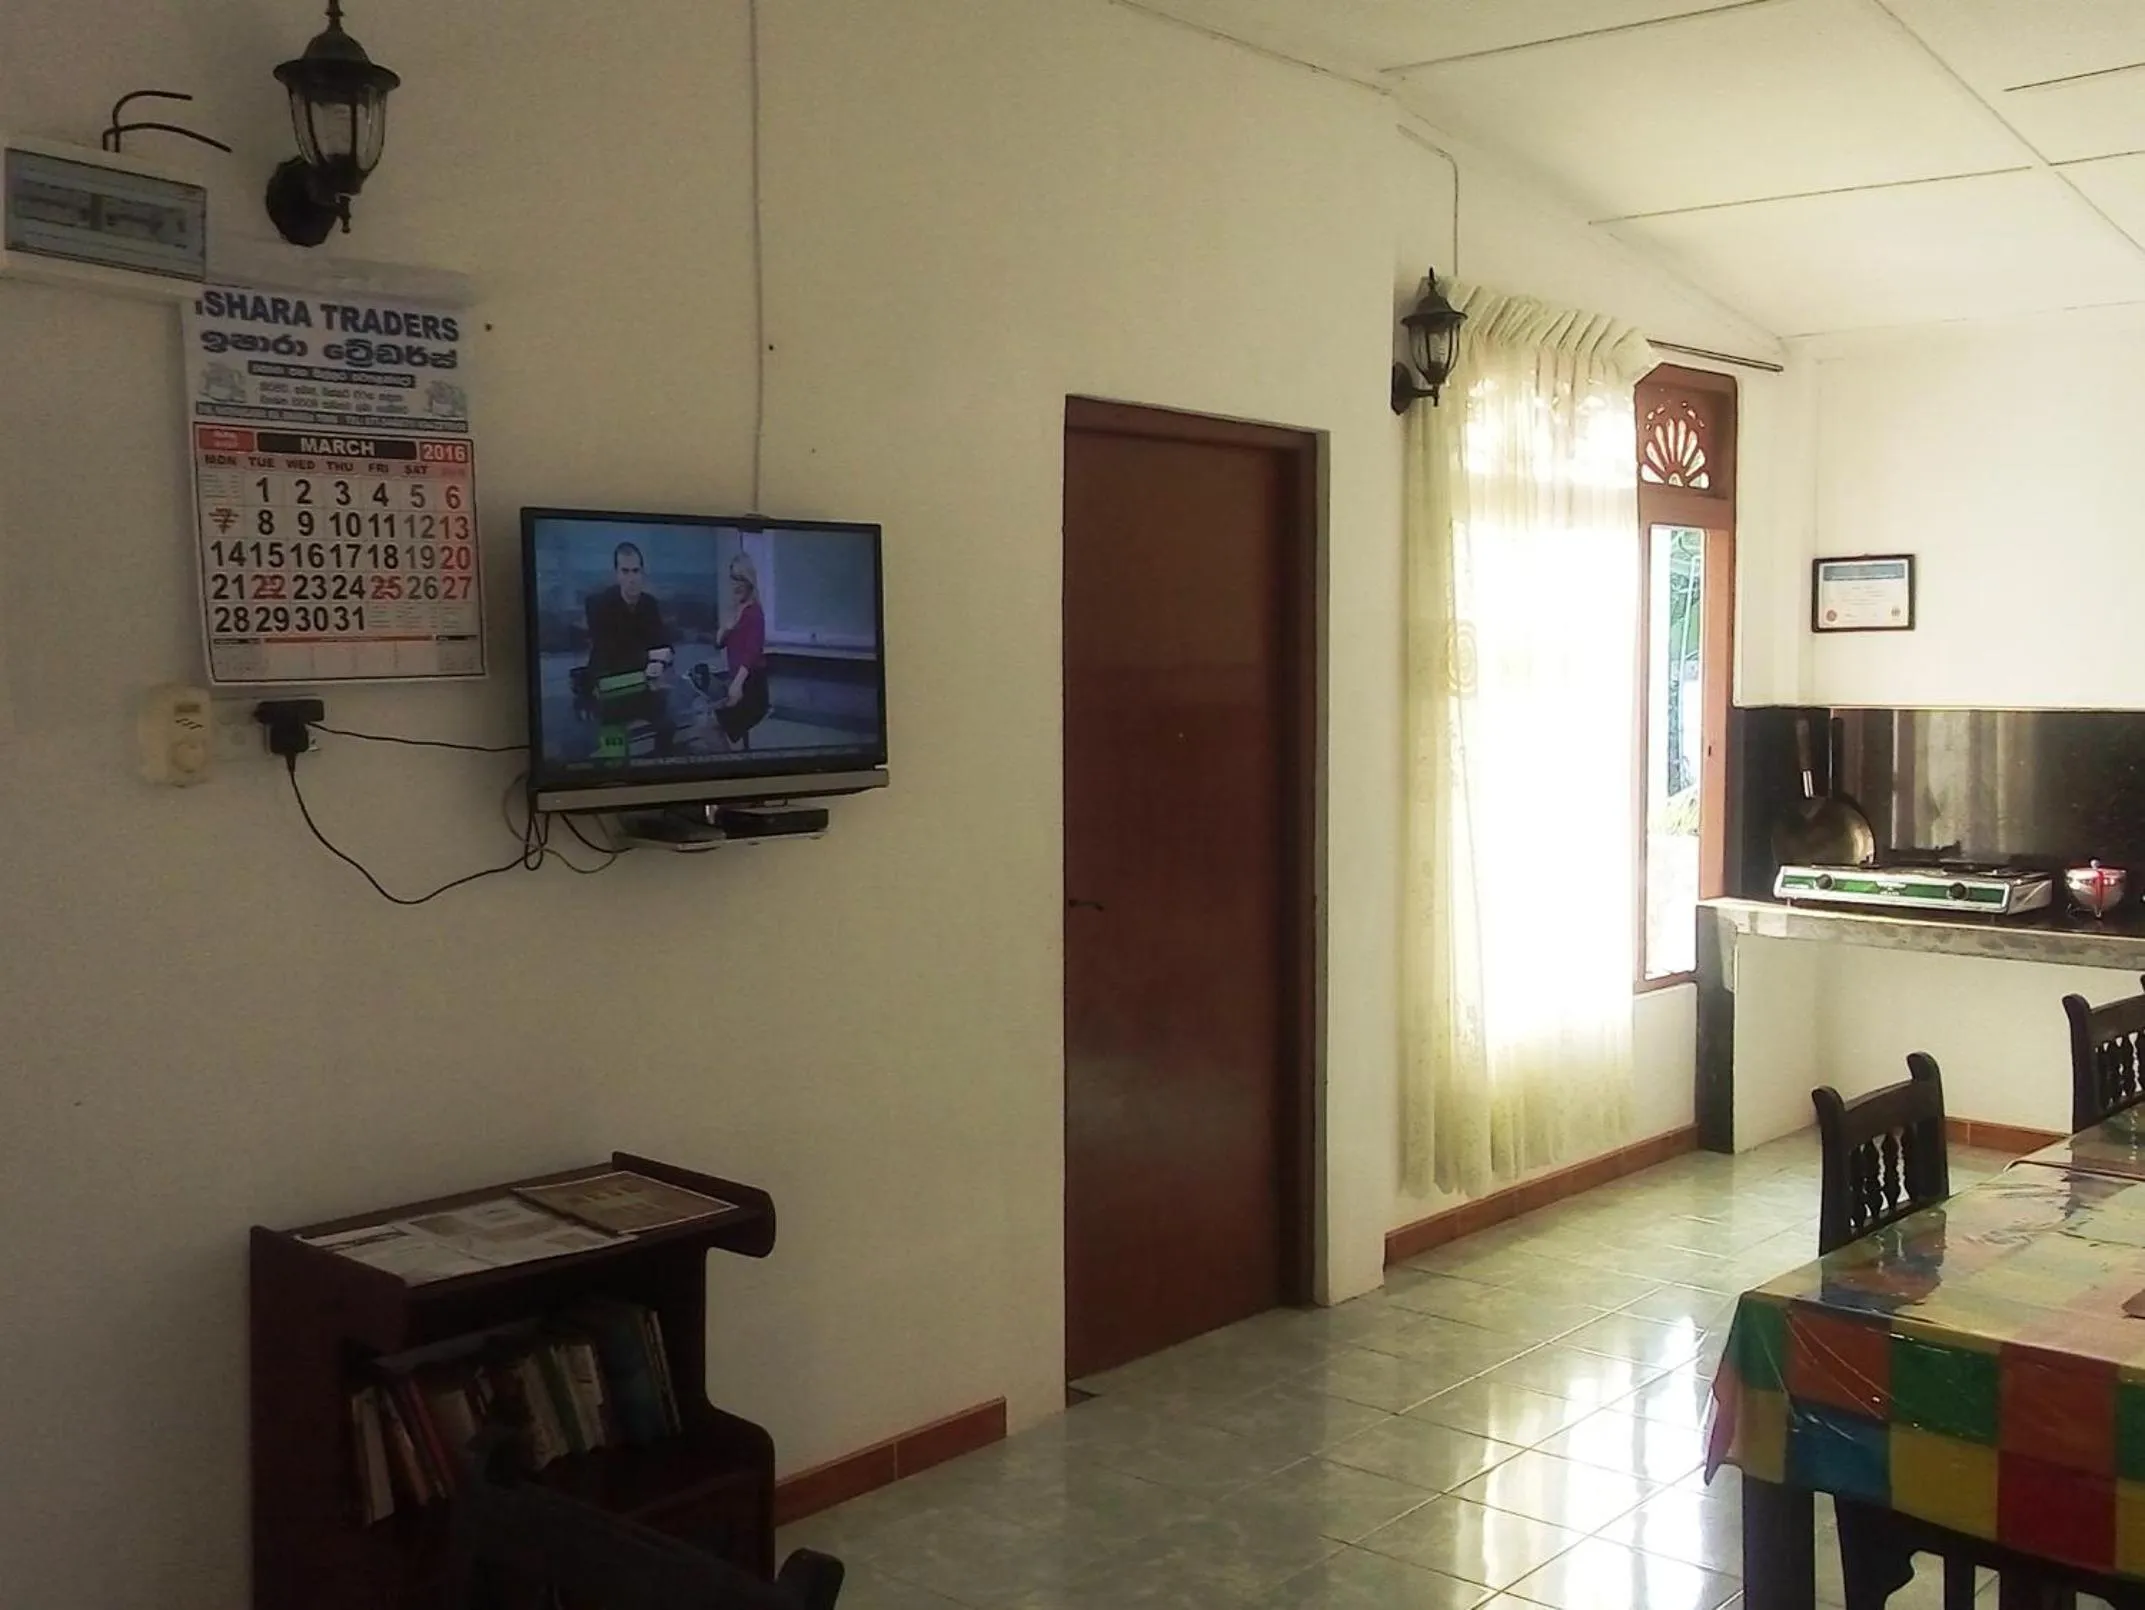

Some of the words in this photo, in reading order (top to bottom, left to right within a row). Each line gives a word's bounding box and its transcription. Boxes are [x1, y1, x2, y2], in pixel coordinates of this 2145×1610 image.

[196, 291, 312, 327] ISHARA
[320, 304, 459, 342] TRADERS
[300, 437, 375, 457] MARCH
[423, 444, 466, 462] 2016
[204, 455, 237, 466] MON
[248, 456, 275, 468] TUE
[286, 459, 315, 470] WED
[327, 461, 354, 472] THU
[368, 462, 389, 473] FRI
[404, 465, 428, 475] SAT
[256, 477, 269, 502] 1
[295, 479, 313, 505] 2
[334, 480, 351, 506] 3
[372, 482, 389, 507] 4
[410, 484, 426, 508] 5
[445, 485, 461, 509] 6
[258, 510, 274, 535] 8
[298, 511, 314, 536] 9
[329, 512, 361, 537] 10
[368, 513, 396, 538] 11
[404, 514, 434, 539] 12
[439, 515, 469, 540] 13
[211, 541, 246, 567] 14
[250, 542, 284, 567] 15
[290, 543, 325, 568] 16
[329, 544, 362, 569] 17
[367, 545, 398, 569] 18
[405, 545, 436, 570] 19
[440, 546, 471, 570] 20
[212, 574, 245, 600] 21
[252, 574, 287, 599] 22
[292, 575, 327, 600] 23
[332, 575, 365, 600] 24
[370, 575, 403, 600] 25
[407, 575, 437, 599] 26
[443, 576, 471, 600] 27
[215, 607, 249, 632] 28
[255, 607, 289, 632] 29
[295, 606, 328, 631] 30
[334, 606, 365, 630] 31
